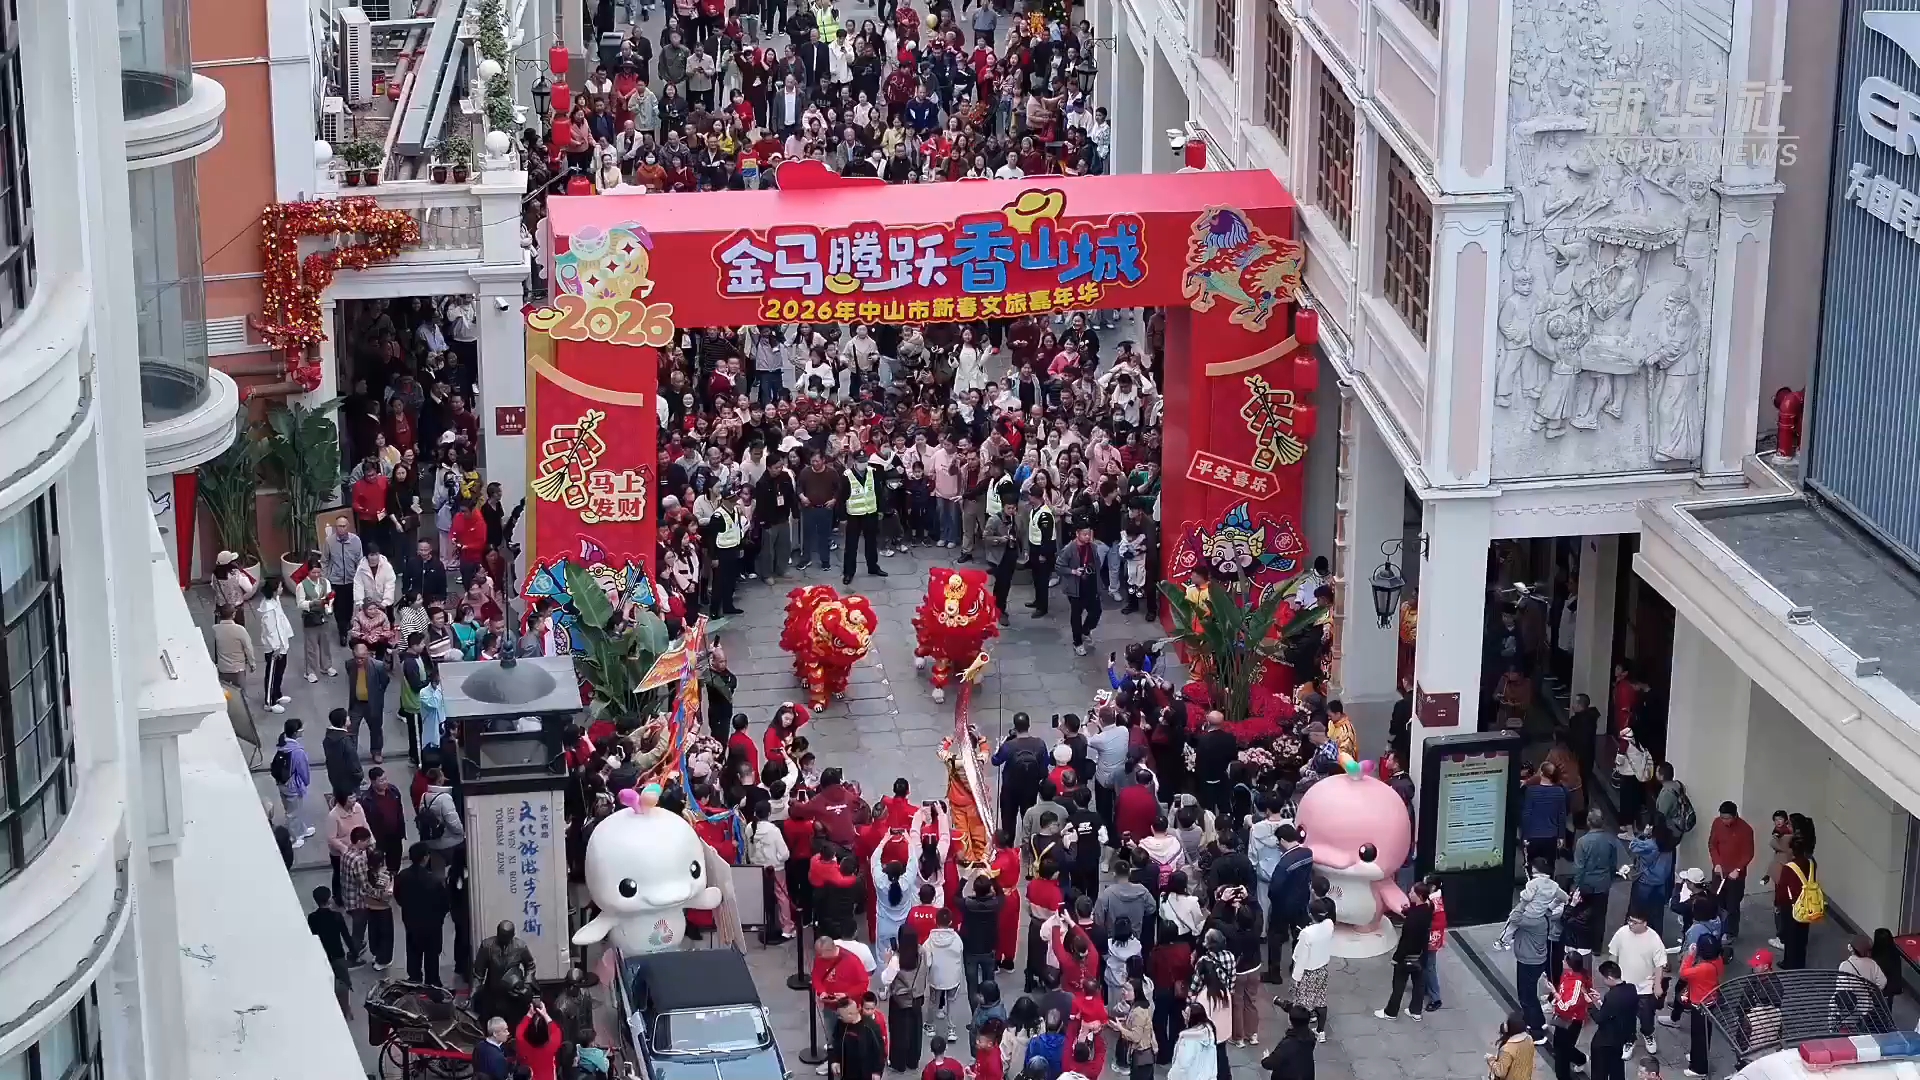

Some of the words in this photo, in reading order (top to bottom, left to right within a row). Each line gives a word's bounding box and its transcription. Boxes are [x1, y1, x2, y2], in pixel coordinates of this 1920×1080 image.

[720, 221, 1142, 296] 金马腾跃香山城
[765, 281, 1101, 321] 2026年中山市新春文旅嘉年华
[550, 294, 674, 347] 2026
[592, 472, 643, 494] 马上
[1195, 459, 1268, 493] 平安喜乐
[593, 498, 642, 518] 发财
[496, 807, 505, 846] TOURISM
[509, 870, 518, 894] ROAD
